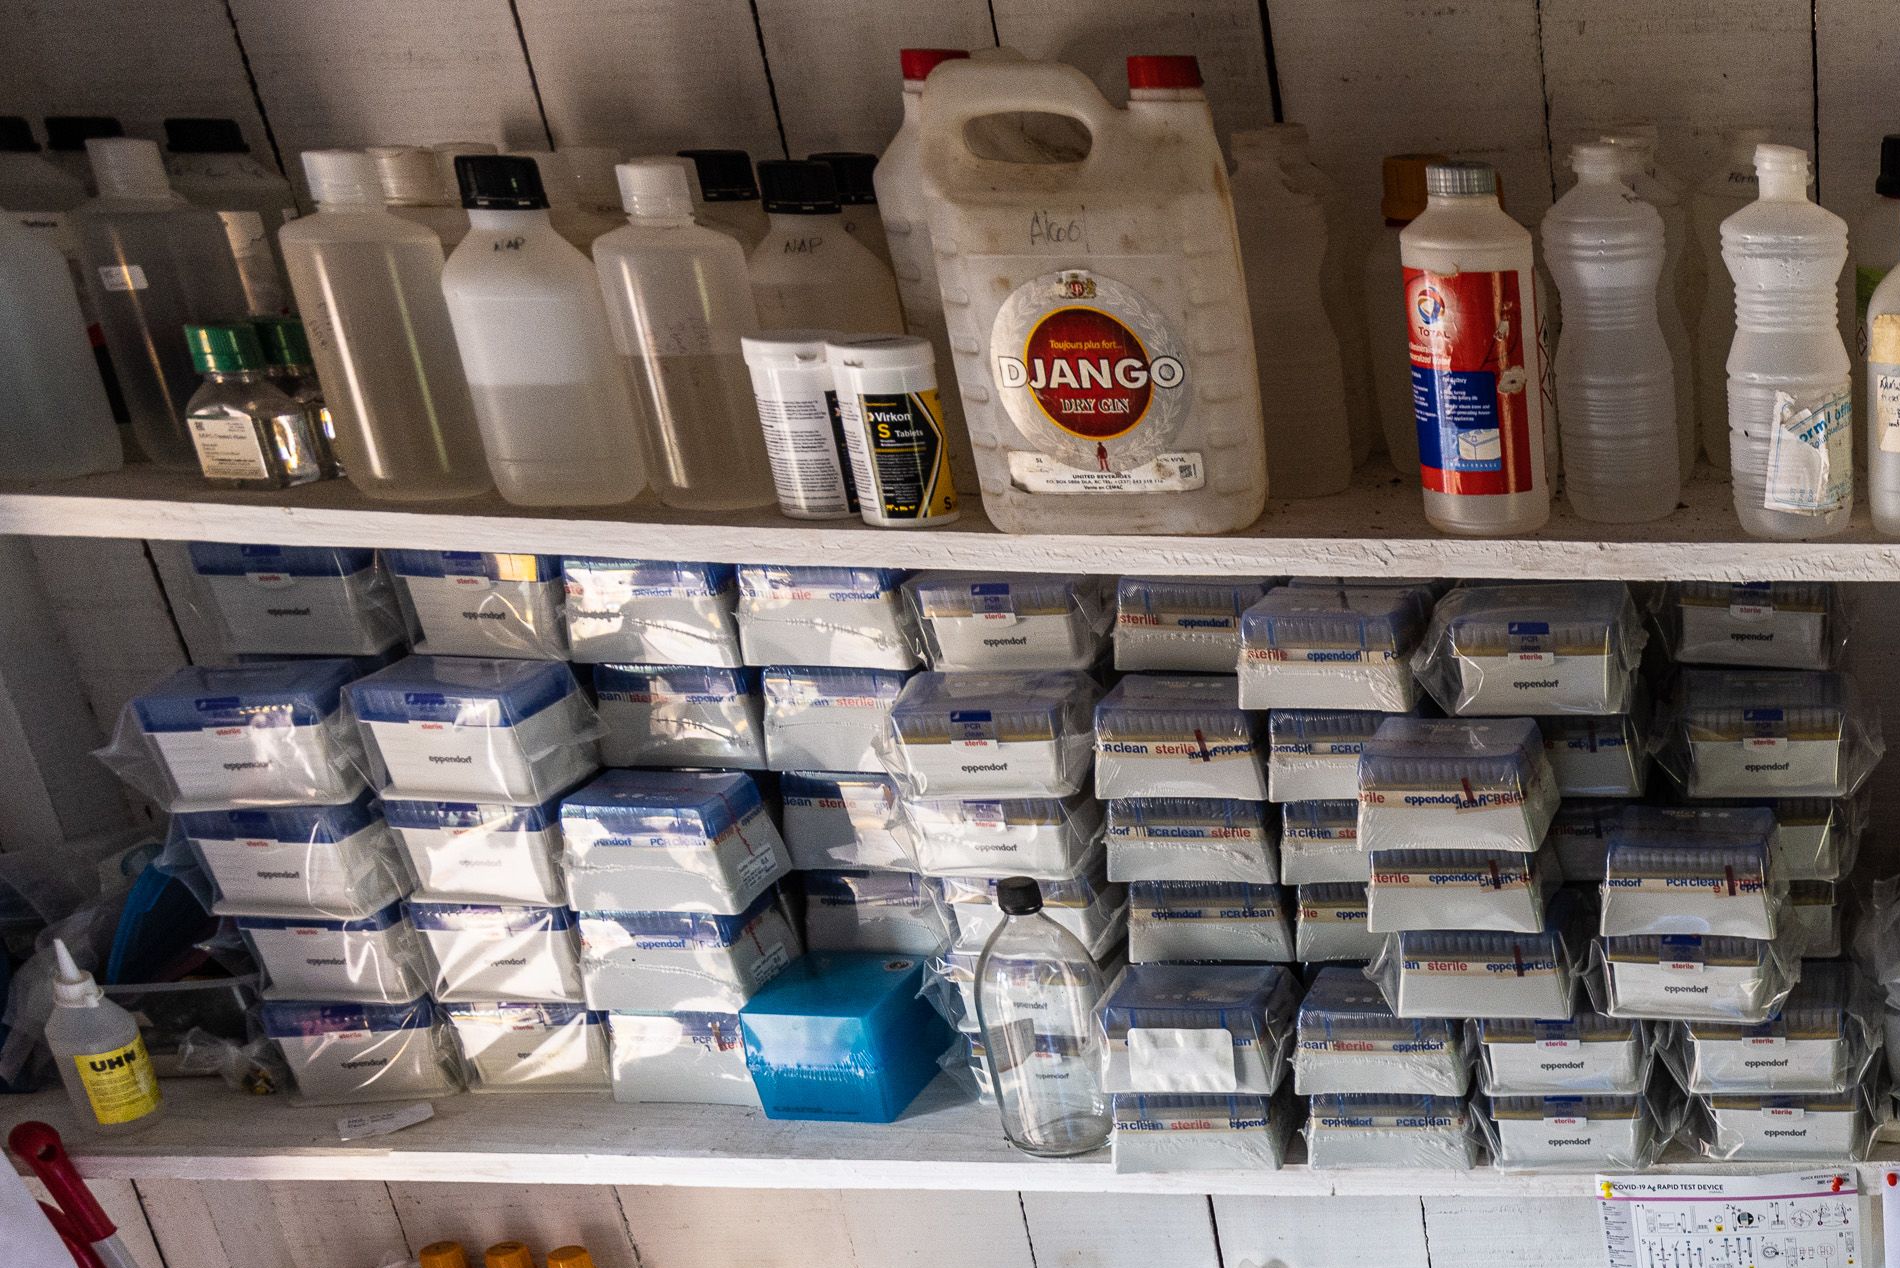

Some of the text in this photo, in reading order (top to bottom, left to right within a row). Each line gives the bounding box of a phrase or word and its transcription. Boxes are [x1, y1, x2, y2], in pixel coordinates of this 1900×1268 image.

[1050, 339, 1083, 350] Toujours
[1084, 340, 1100, 350] plus
[997, 355, 1185, 389] DJANGO
[1061, 398, 1129, 413] DRY GIN
[874, 412, 911, 422] Virkon
[877, 423, 924, 438] S Tablets
[1120, 613, 1159, 626] sterile
[1178, 618, 1230, 629] eppendorf
[984, 636, 1027, 647] eppendorf
[1730, 632, 1774, 642] eppendorf
[1247, 649, 1361, 662] sterile eppendorf
[1513, 679, 1559, 690] eppendorf
[1113, 742, 1195, 755] clean sterile
[428, 755, 473, 766] eppendorf
[961, 762, 1008, 774] eppendorf
[1172, 828, 1250, 838] clean sterile
[1666, 876, 1724, 888] PCR clean
[1152, 911, 1202, 921] eppendorf
[636, 938, 687, 950] eppendorf
[1664, 984, 1709, 995] eppendorf
[1540, 1060, 1585, 1071] eppendorf
[1171, 1119, 1211, 1130] sterile
[1764, 1128, 1807, 1139] eppendorf
